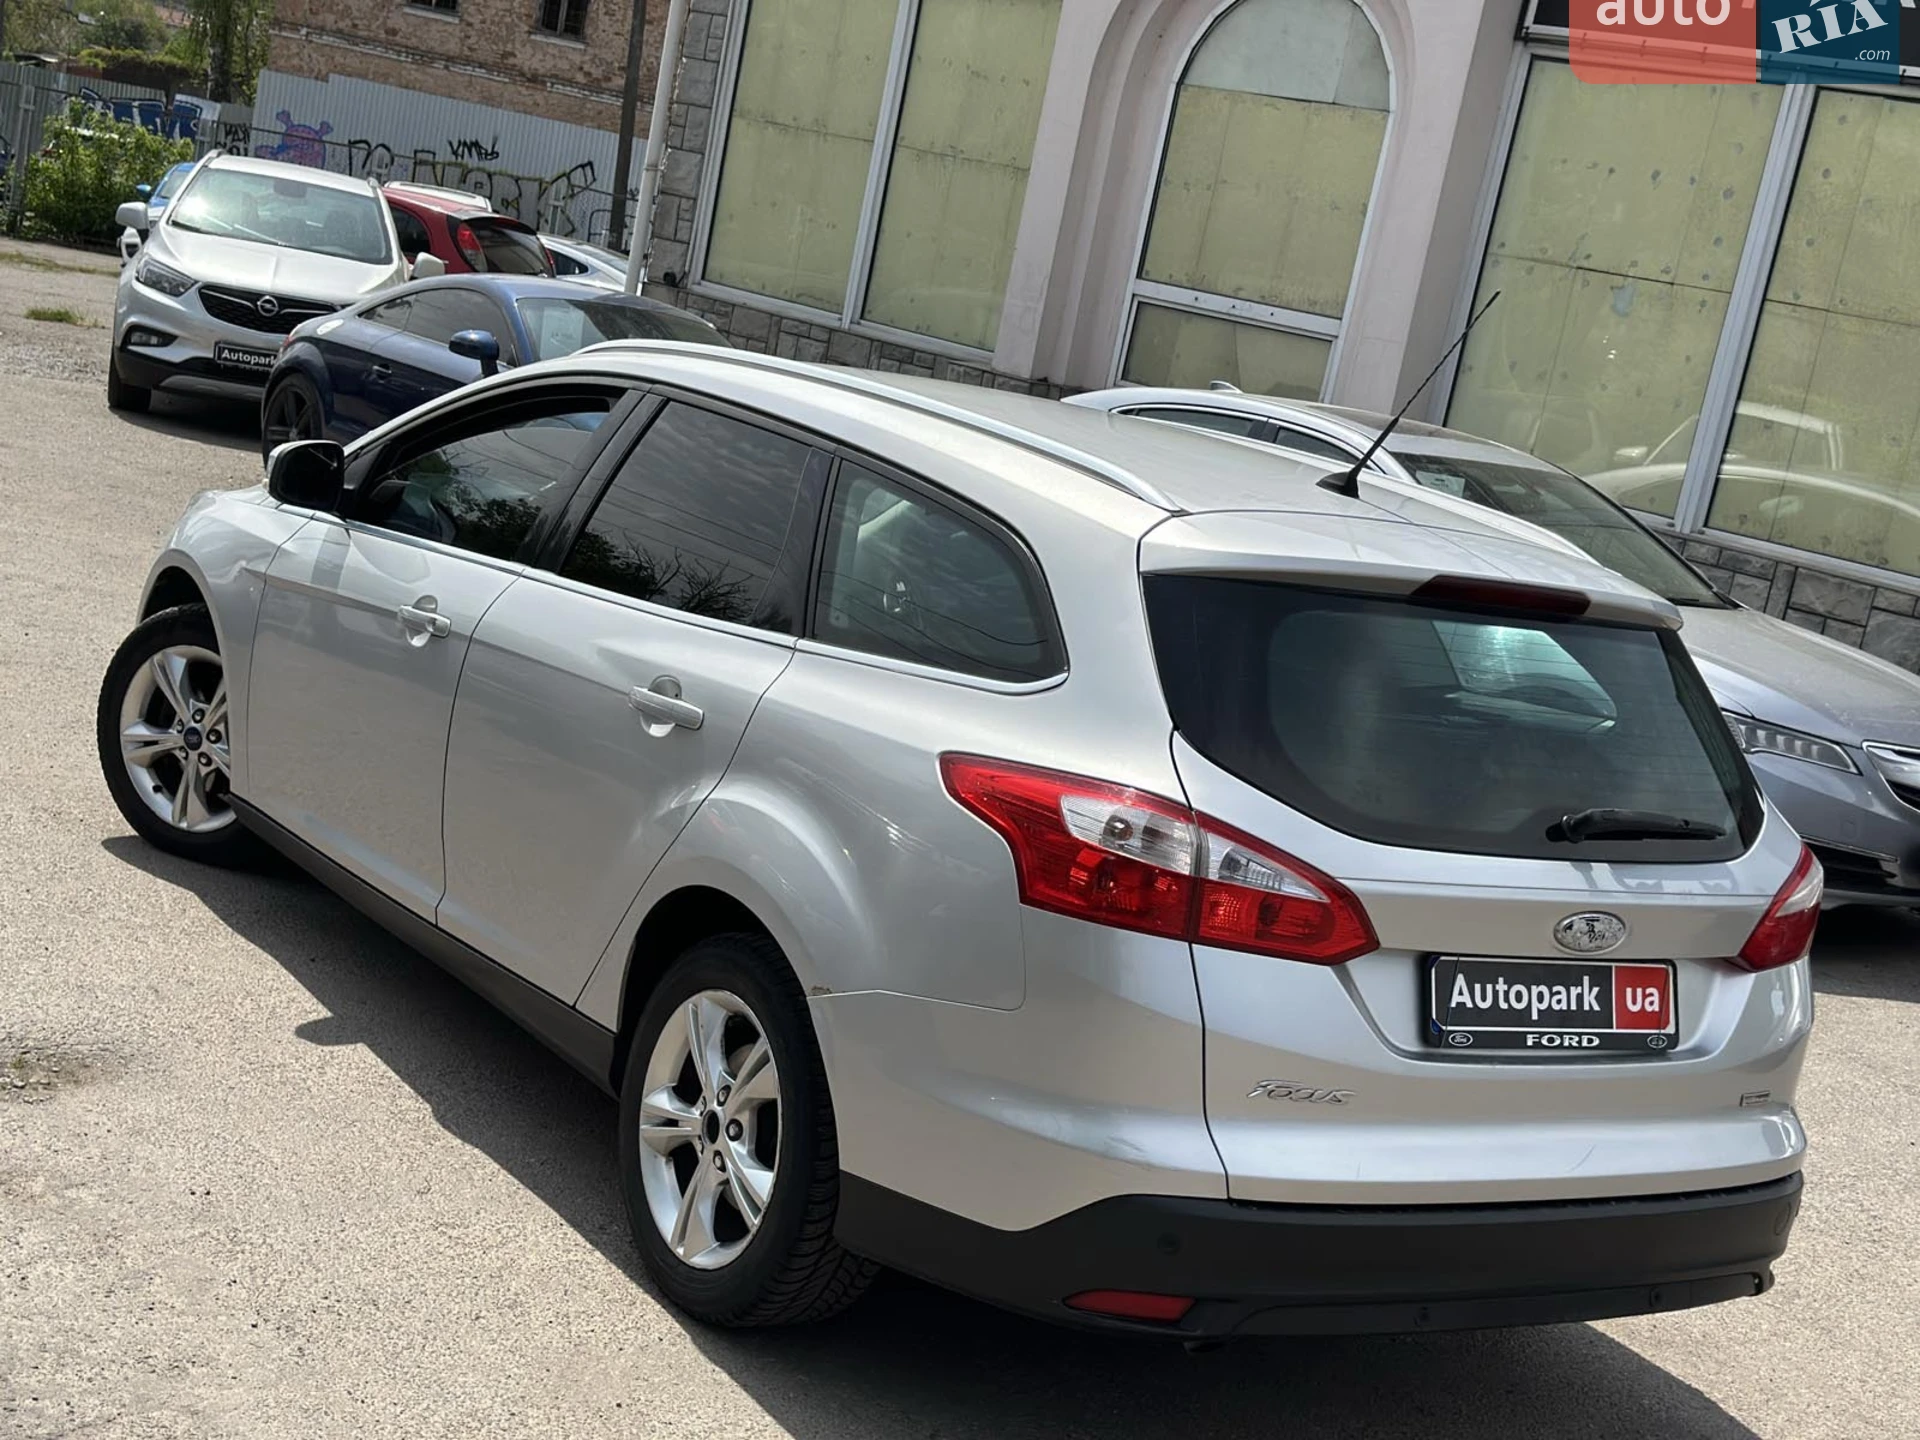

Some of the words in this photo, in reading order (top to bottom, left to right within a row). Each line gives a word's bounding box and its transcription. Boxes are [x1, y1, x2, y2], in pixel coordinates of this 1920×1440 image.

[1450, 973, 1601, 1021] Autopark
[1625, 986, 1660, 1013] ua
[1526, 1034, 1600, 1048] FORD
